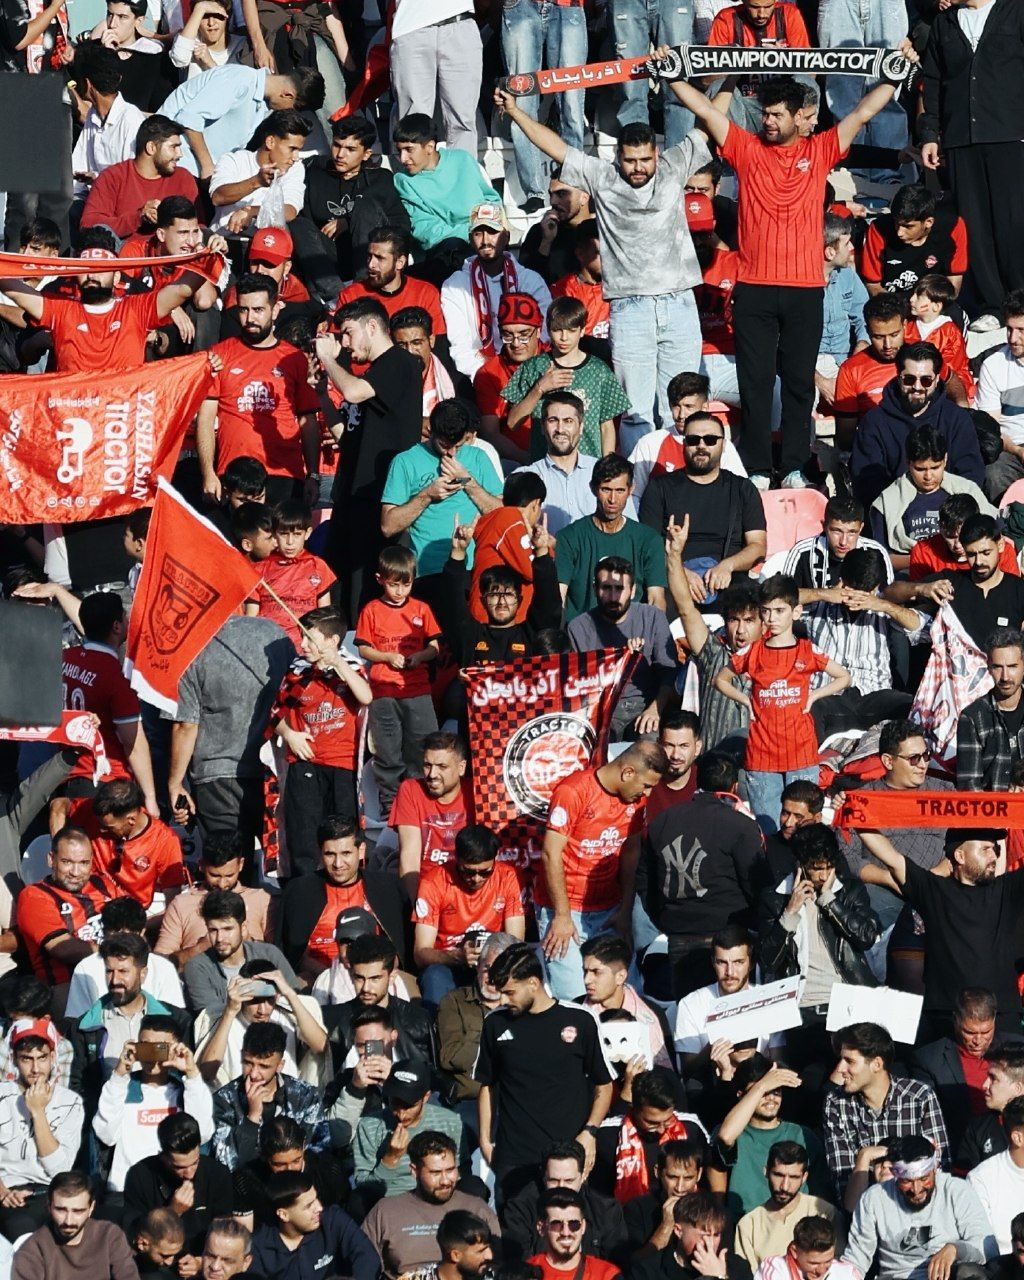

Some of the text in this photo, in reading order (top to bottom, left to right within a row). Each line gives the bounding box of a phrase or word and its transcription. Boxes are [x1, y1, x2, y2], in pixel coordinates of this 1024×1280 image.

[541, 63, 622, 88] آذربایجان
[473, 669, 559, 706] آذربایجان
[759, 688, 801, 697] AIRLINES
[521, 719, 586, 743] TRACTOR
[917, 799, 1008, 817] TRACTOR
[430, 849, 449, 865] 85
